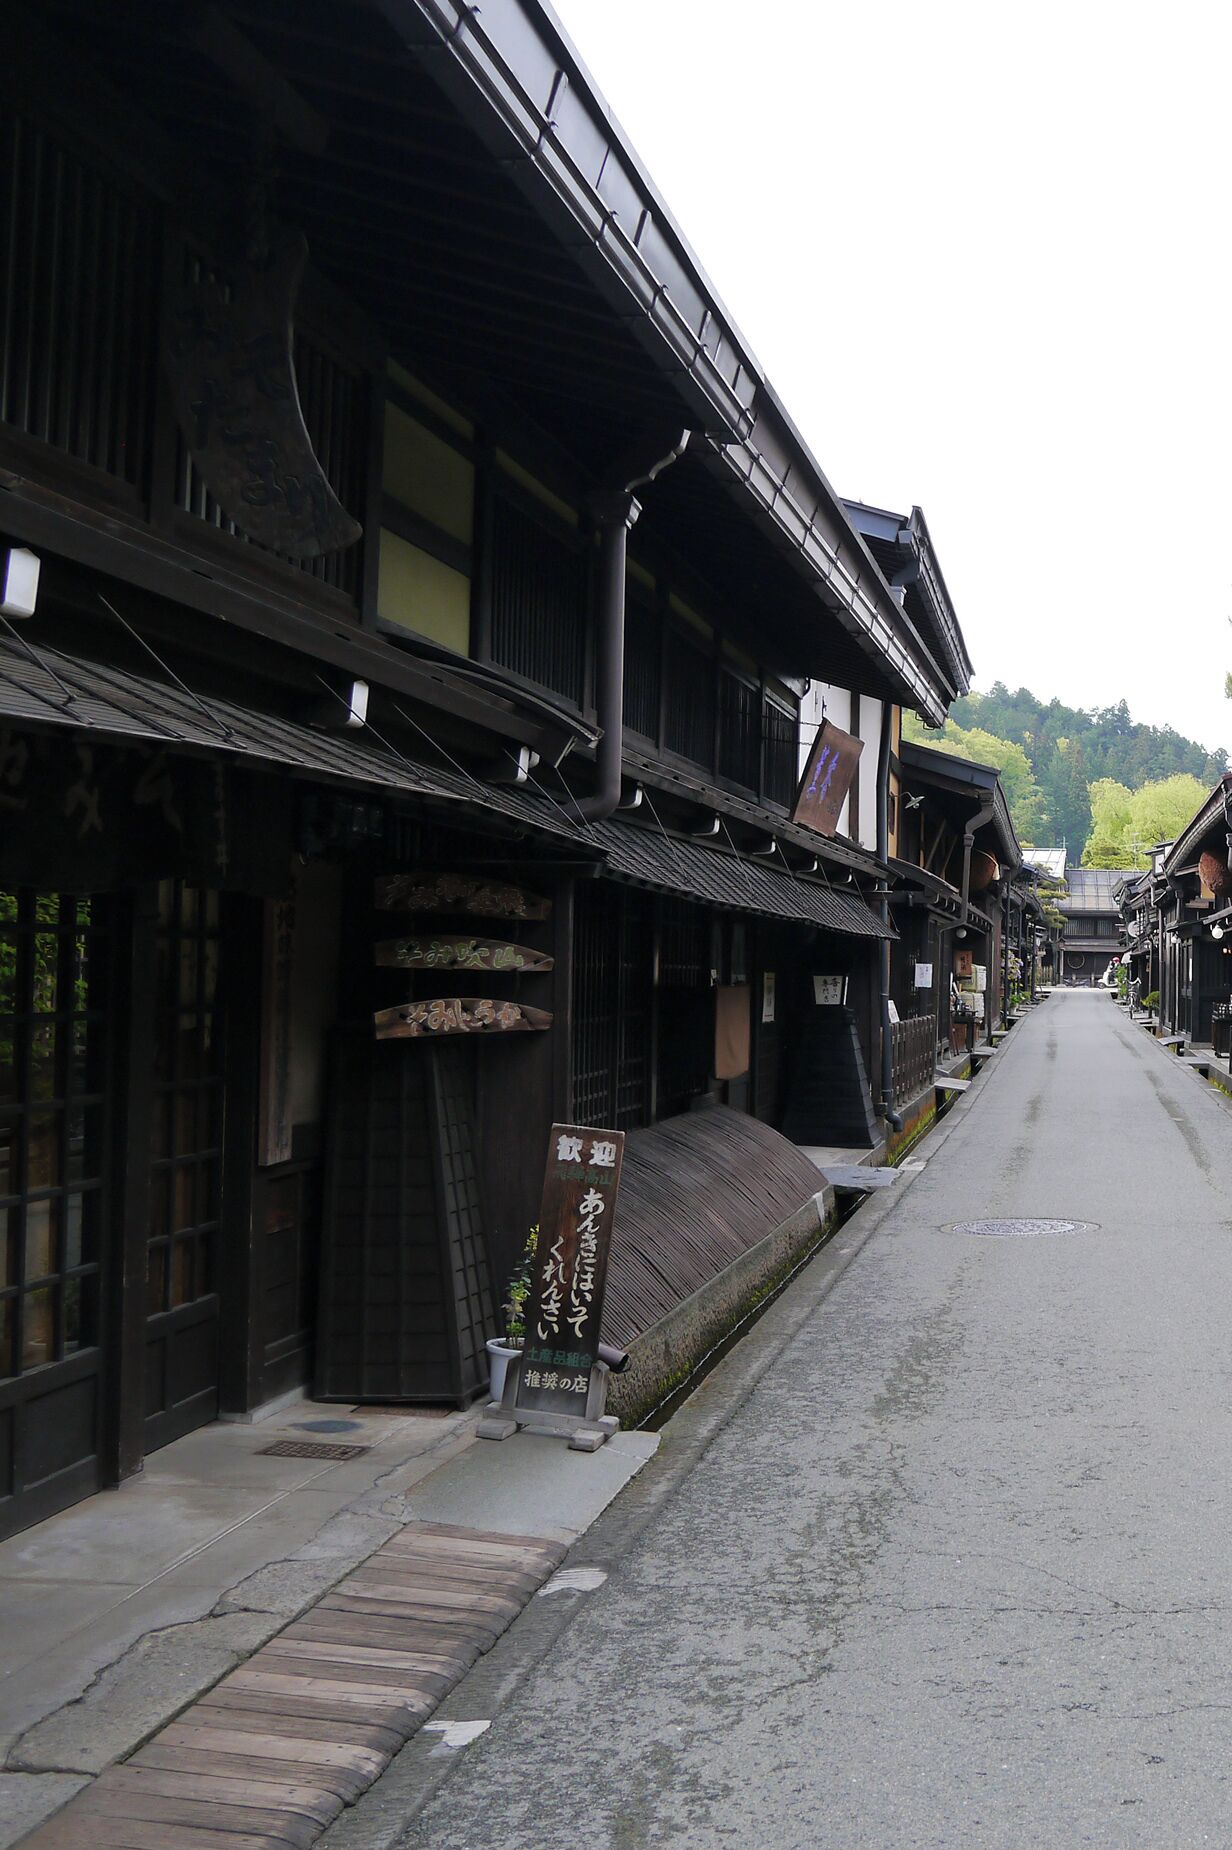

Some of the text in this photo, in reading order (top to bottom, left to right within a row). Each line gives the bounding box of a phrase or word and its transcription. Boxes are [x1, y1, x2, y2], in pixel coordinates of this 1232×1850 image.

[556, 1134, 617, 1168] 歓迎
[567, 1188, 605, 1339] あんきにはいって
[538, 1235, 567, 1341] くれんさい
[526, 1346, 593, 1369] 土産品組合
[524, 1369, 589, 1394] 推奨の店
